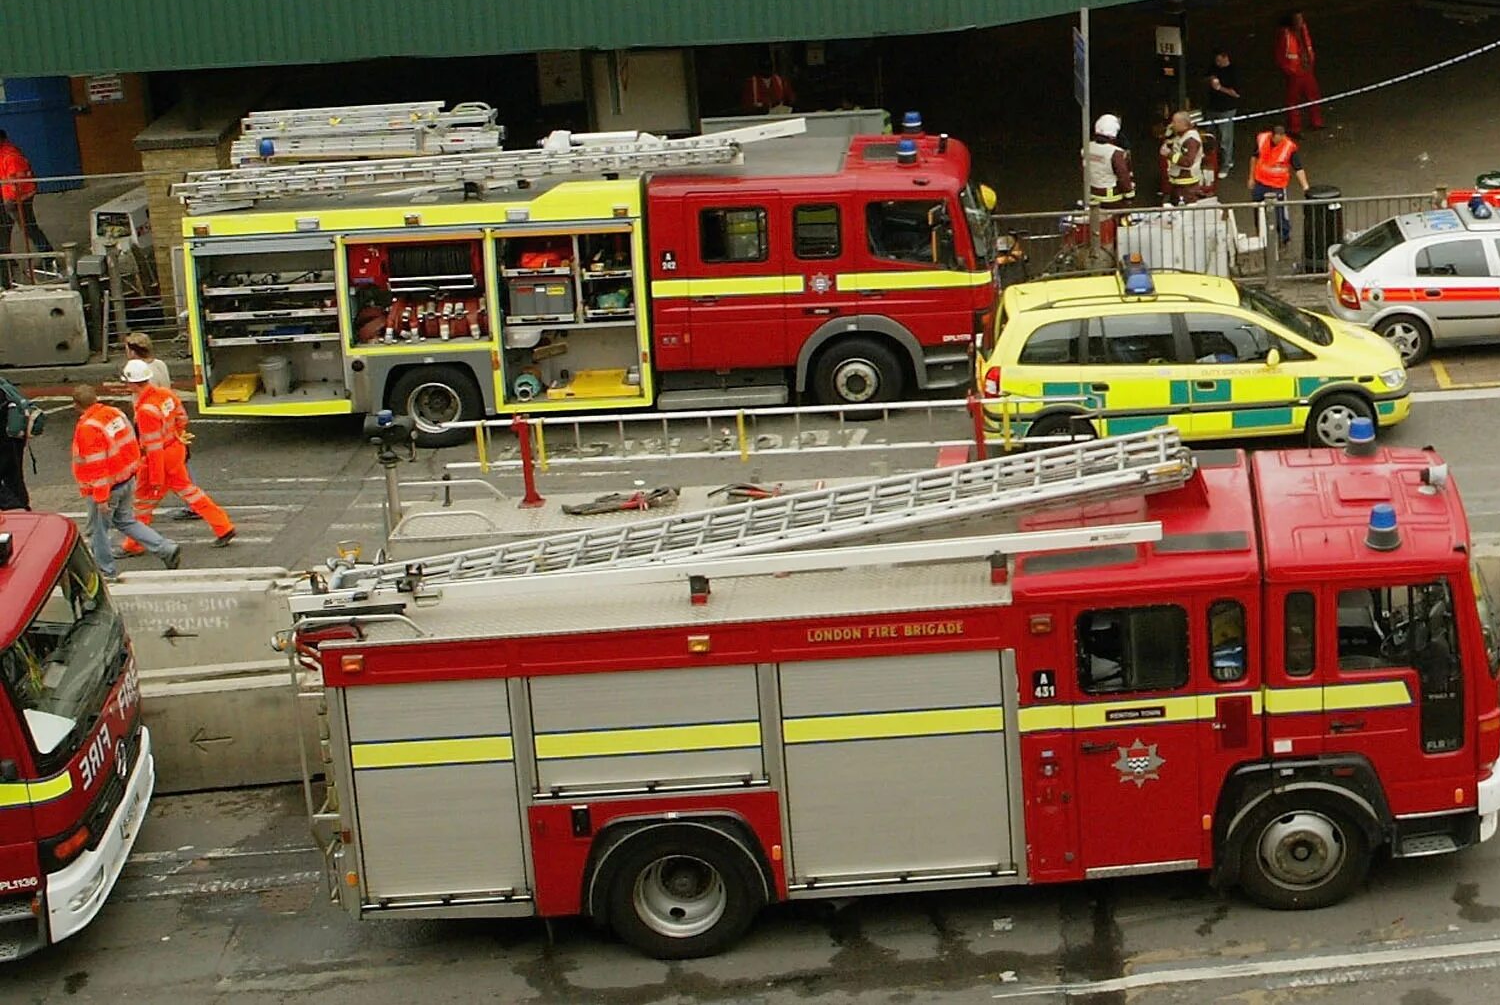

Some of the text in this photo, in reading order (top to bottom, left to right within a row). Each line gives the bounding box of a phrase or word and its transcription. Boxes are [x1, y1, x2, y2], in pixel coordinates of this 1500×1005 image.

[807, 620, 964, 643] LONDON FIRE BRIGADE
[1039, 673, 1048, 685] A
[1034, 685, 1056, 698] 431
